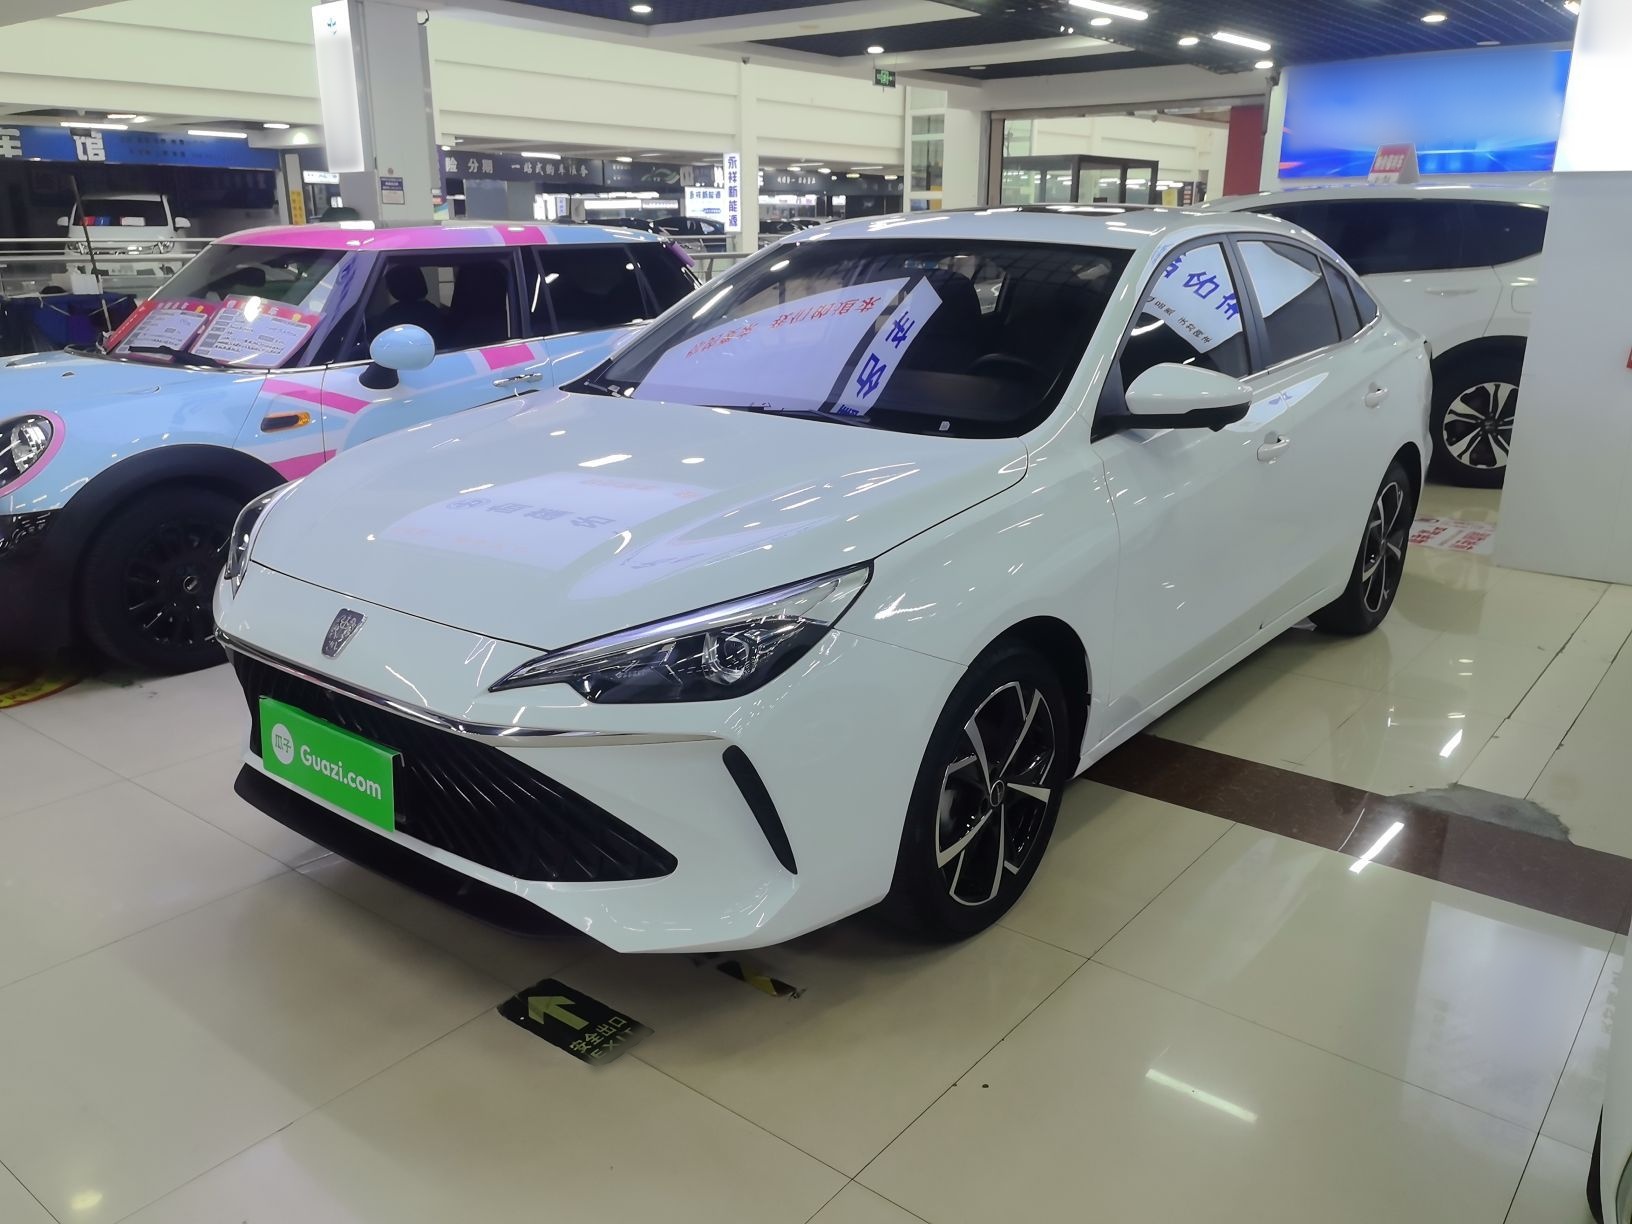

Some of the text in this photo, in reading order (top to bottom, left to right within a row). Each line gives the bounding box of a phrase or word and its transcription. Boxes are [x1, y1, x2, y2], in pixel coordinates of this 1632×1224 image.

[468, 158, 493, 174] 分期
[511, 161, 589, 178] 一站式购车服务
[728, 156, 738, 227] 永祥新能源
[275, 734, 292, 754] 瓜子
[300, 744, 382, 800] Guazi.com
[569, 1016, 628, 1054] 安全出口
[590, 1027, 633, 1059] EXIT
